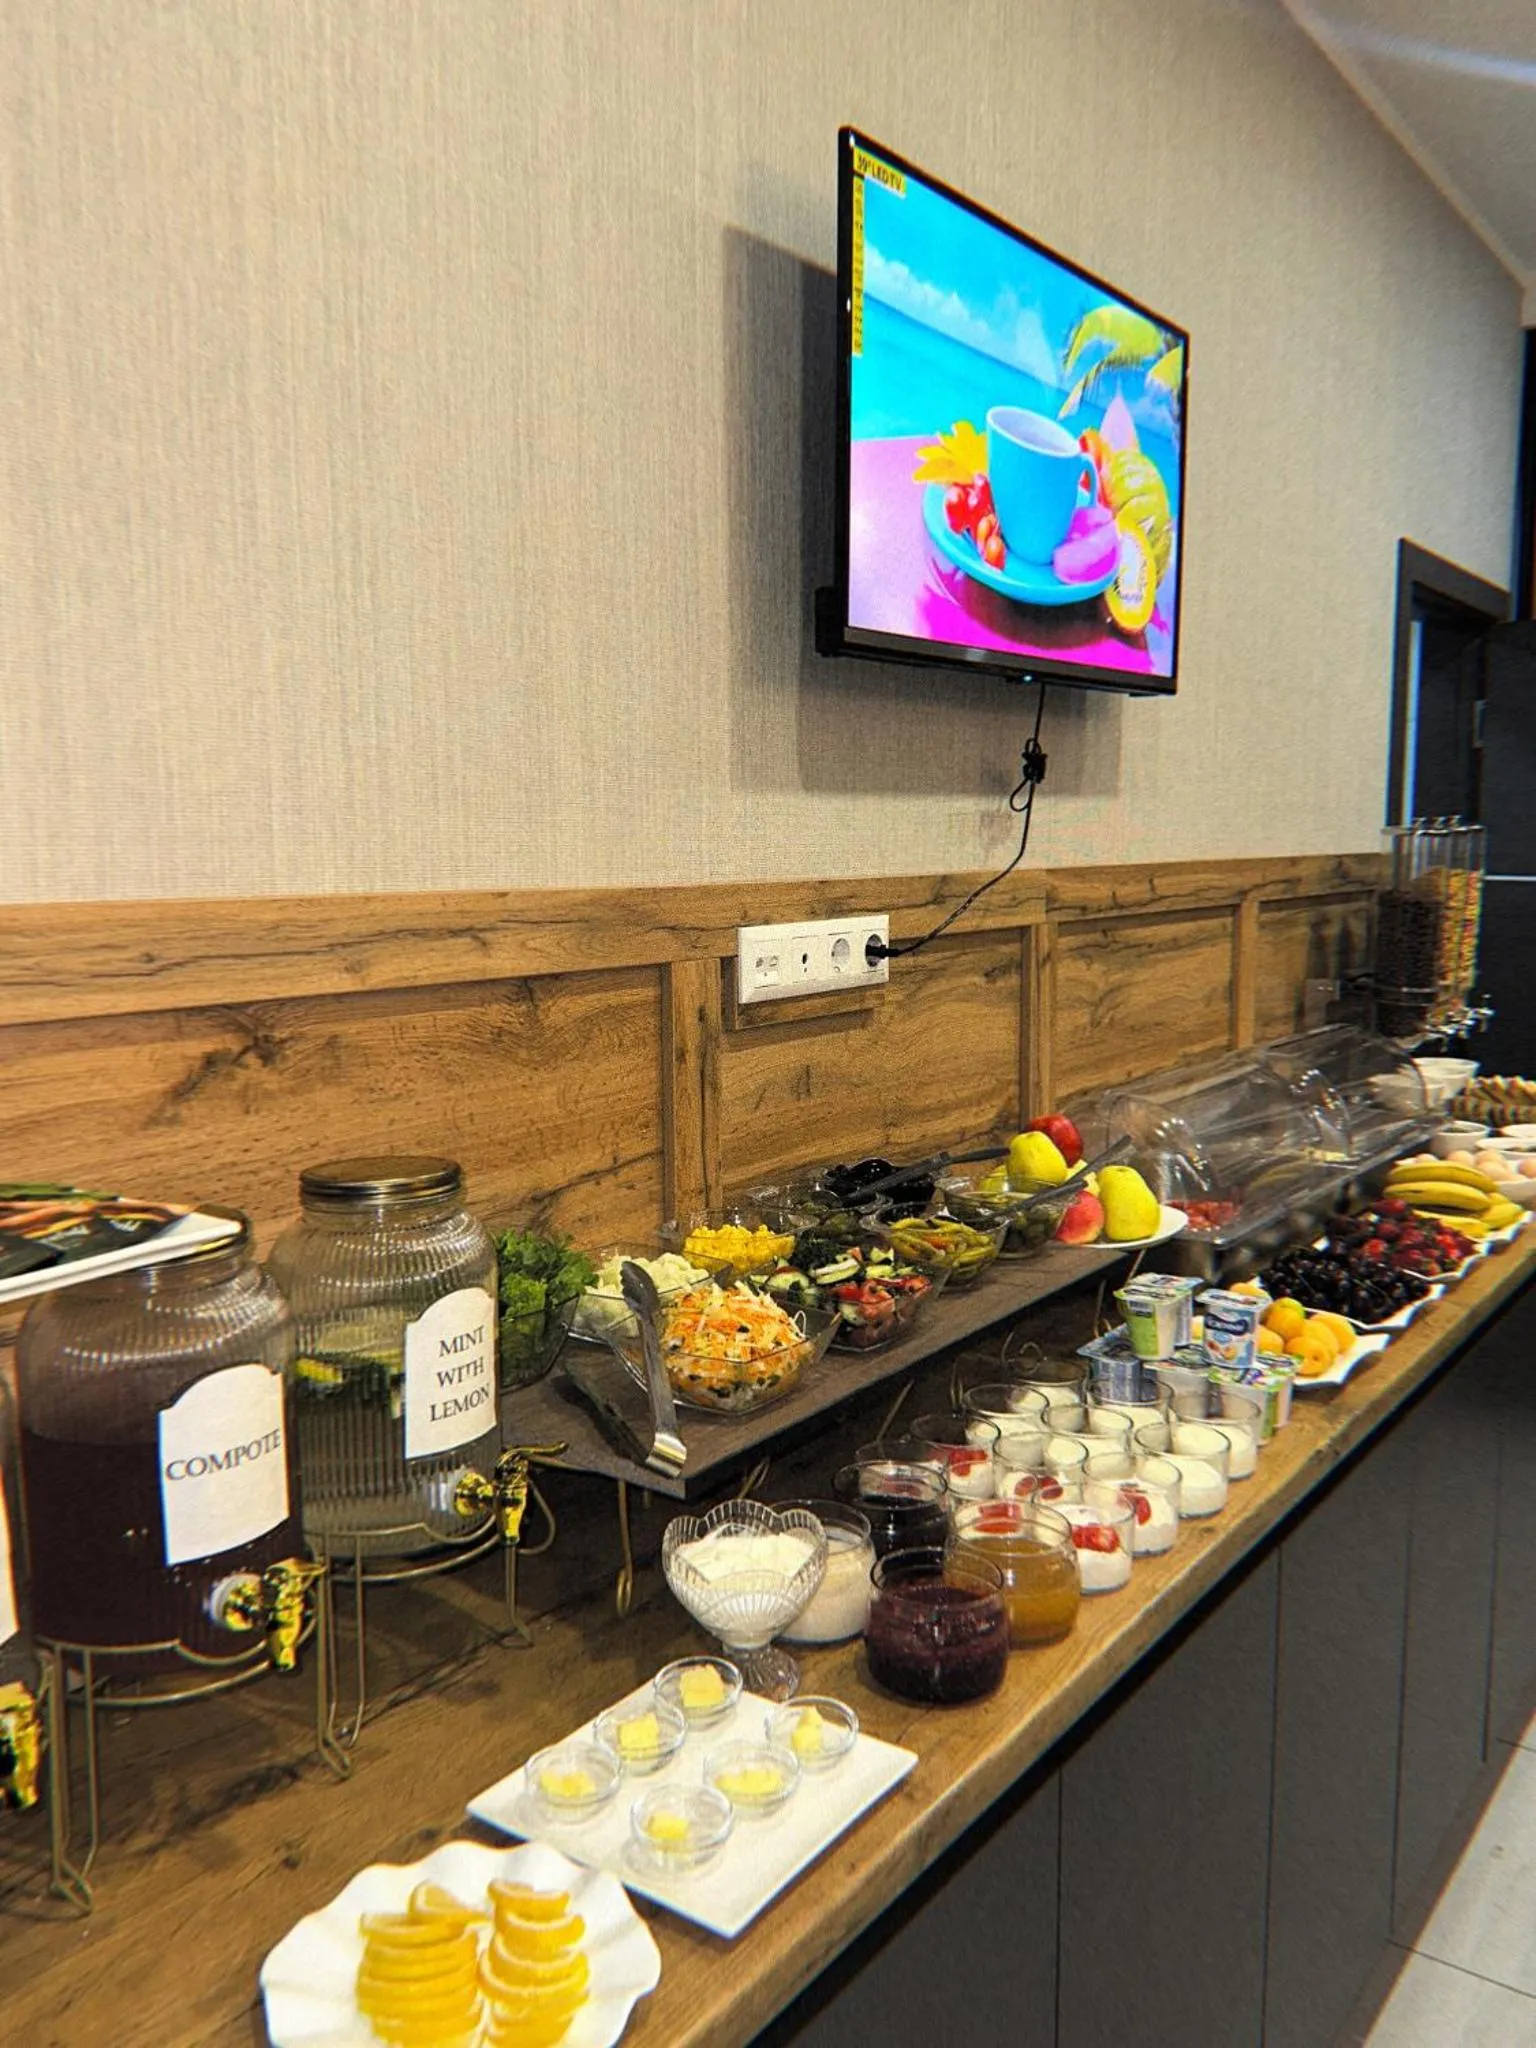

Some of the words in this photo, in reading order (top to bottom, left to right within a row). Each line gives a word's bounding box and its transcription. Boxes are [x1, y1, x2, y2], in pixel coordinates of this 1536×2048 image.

[438, 1325, 485, 1358] MINT
[436, 1356, 485, 1388] WITH
[429, 1383, 490, 1422] LEMON
[165, 1428, 282, 1481] COMPOTE
